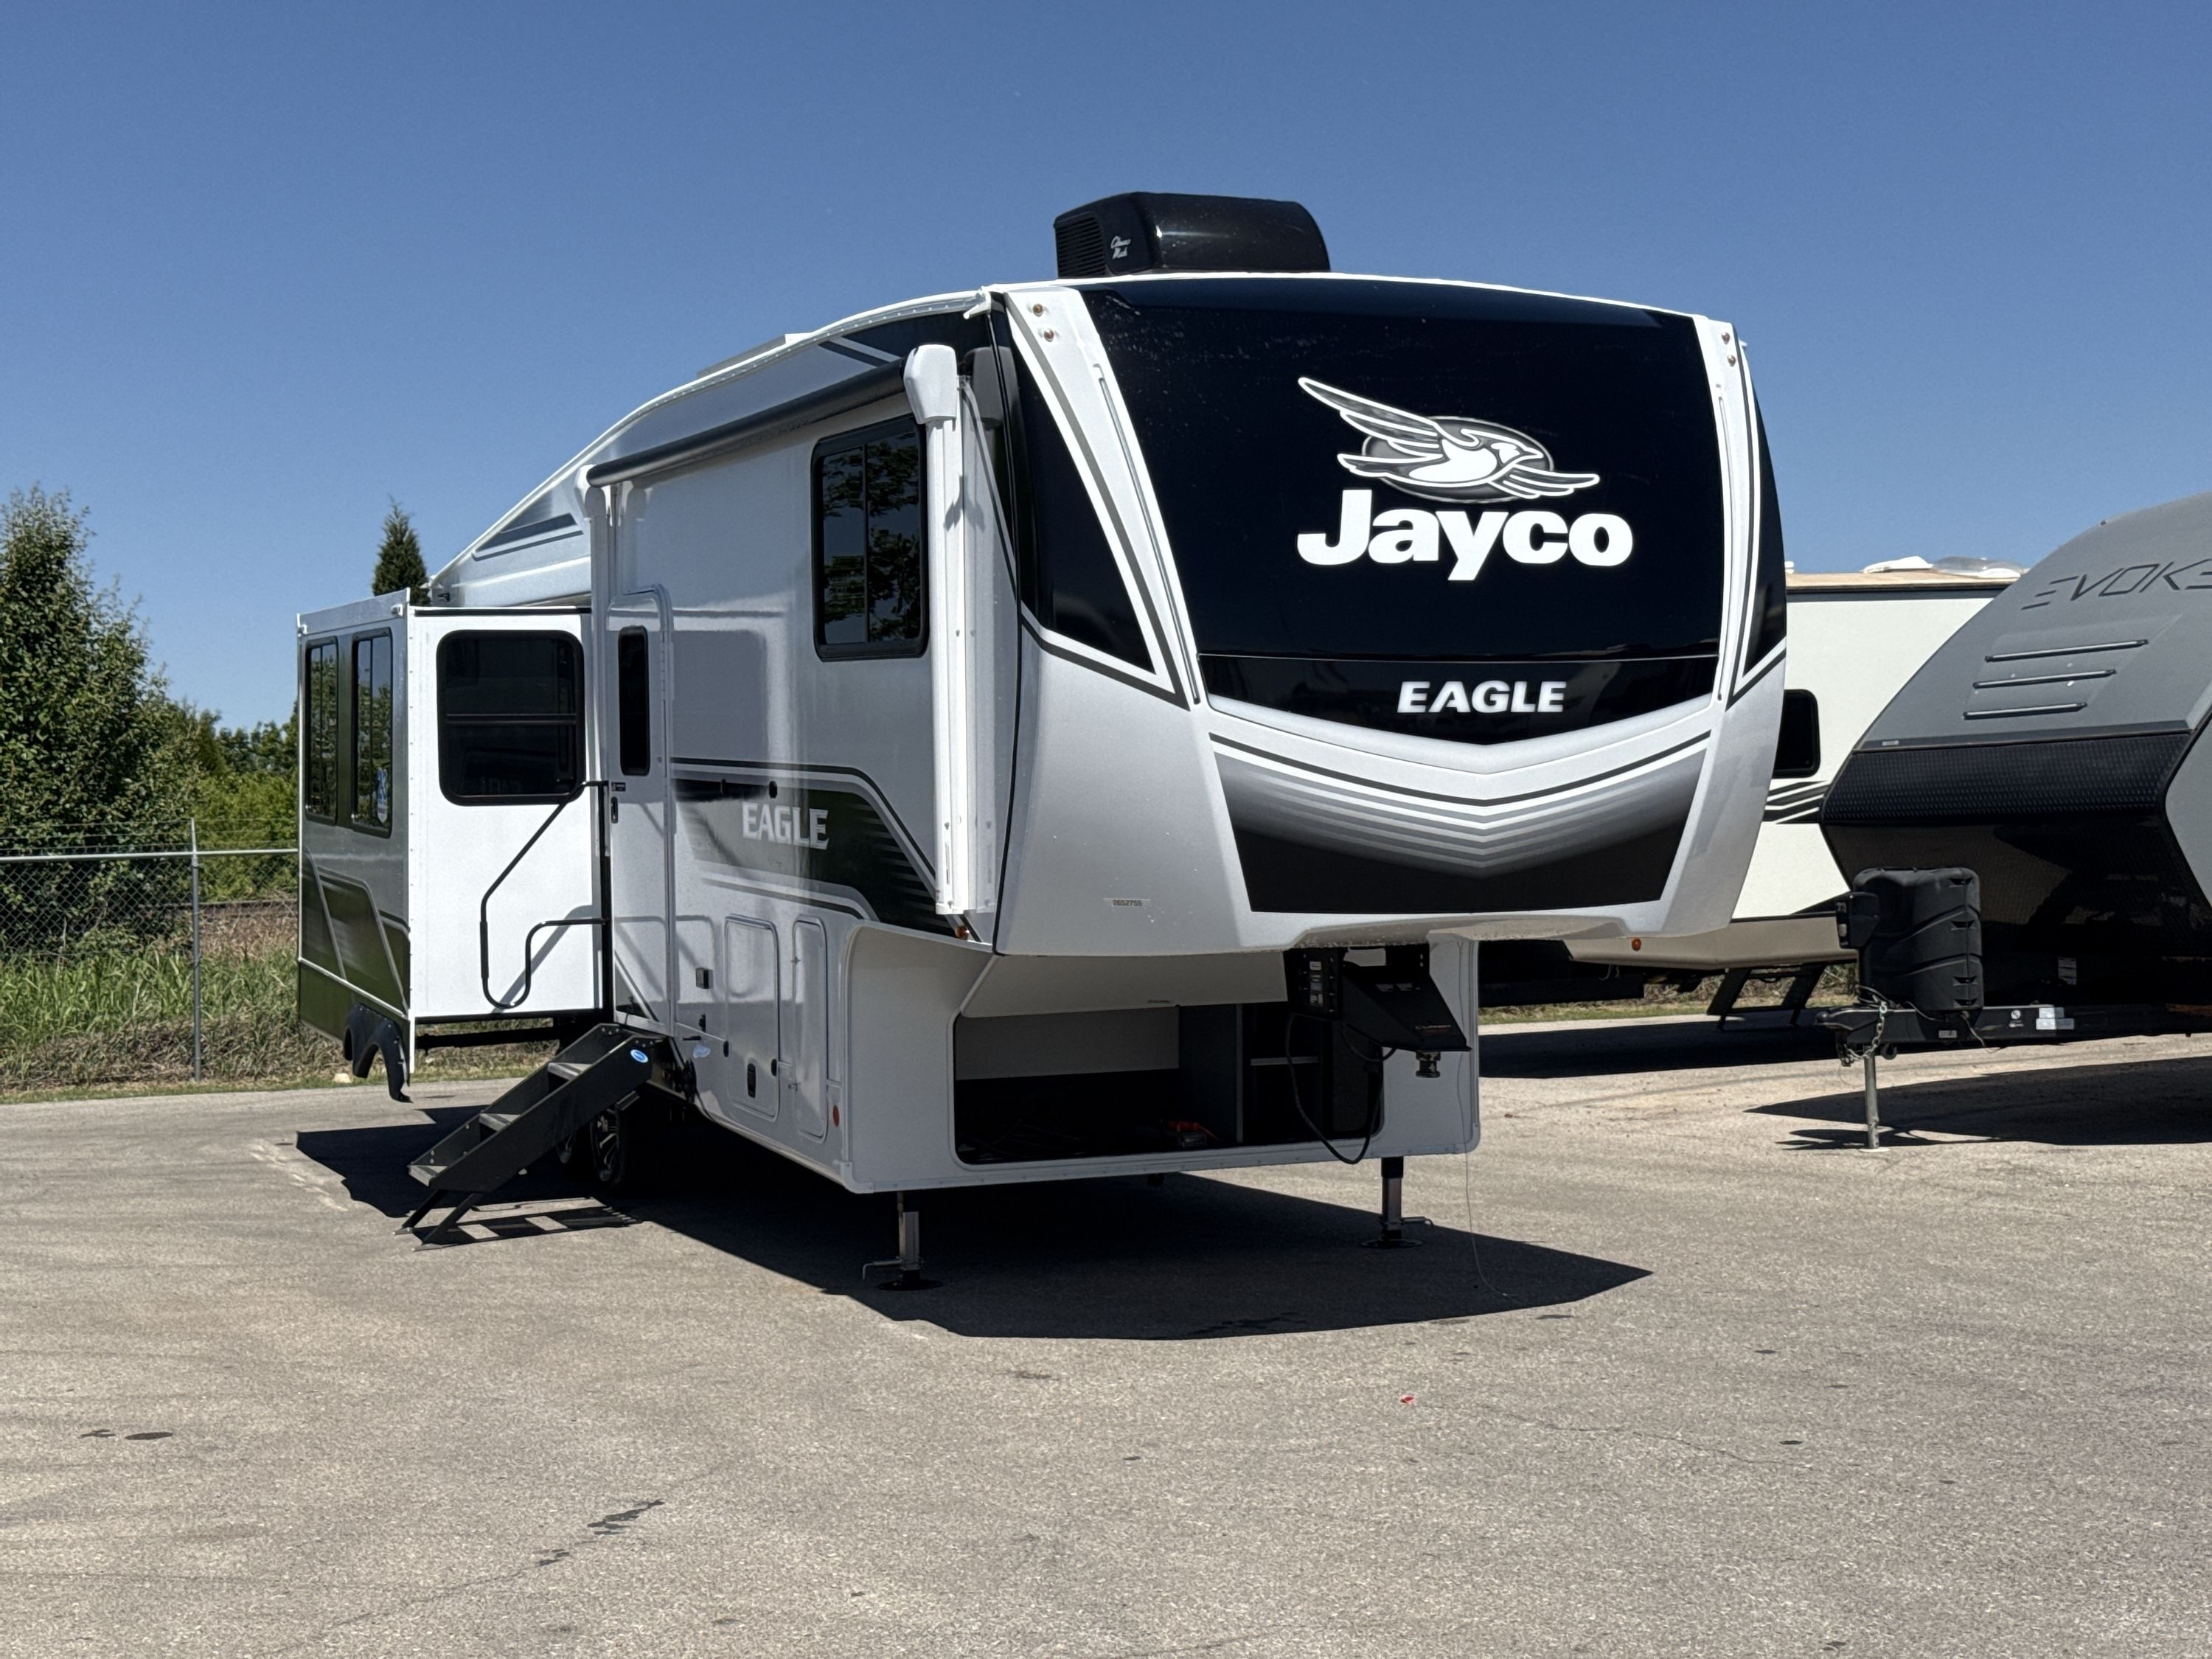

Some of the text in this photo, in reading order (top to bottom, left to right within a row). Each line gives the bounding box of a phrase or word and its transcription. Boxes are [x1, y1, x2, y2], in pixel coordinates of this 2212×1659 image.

[1297, 490, 1633, 580] Jayco
[1397, 681, 1567, 713] EAGLE
[742, 801, 830, 850] EAGLE
